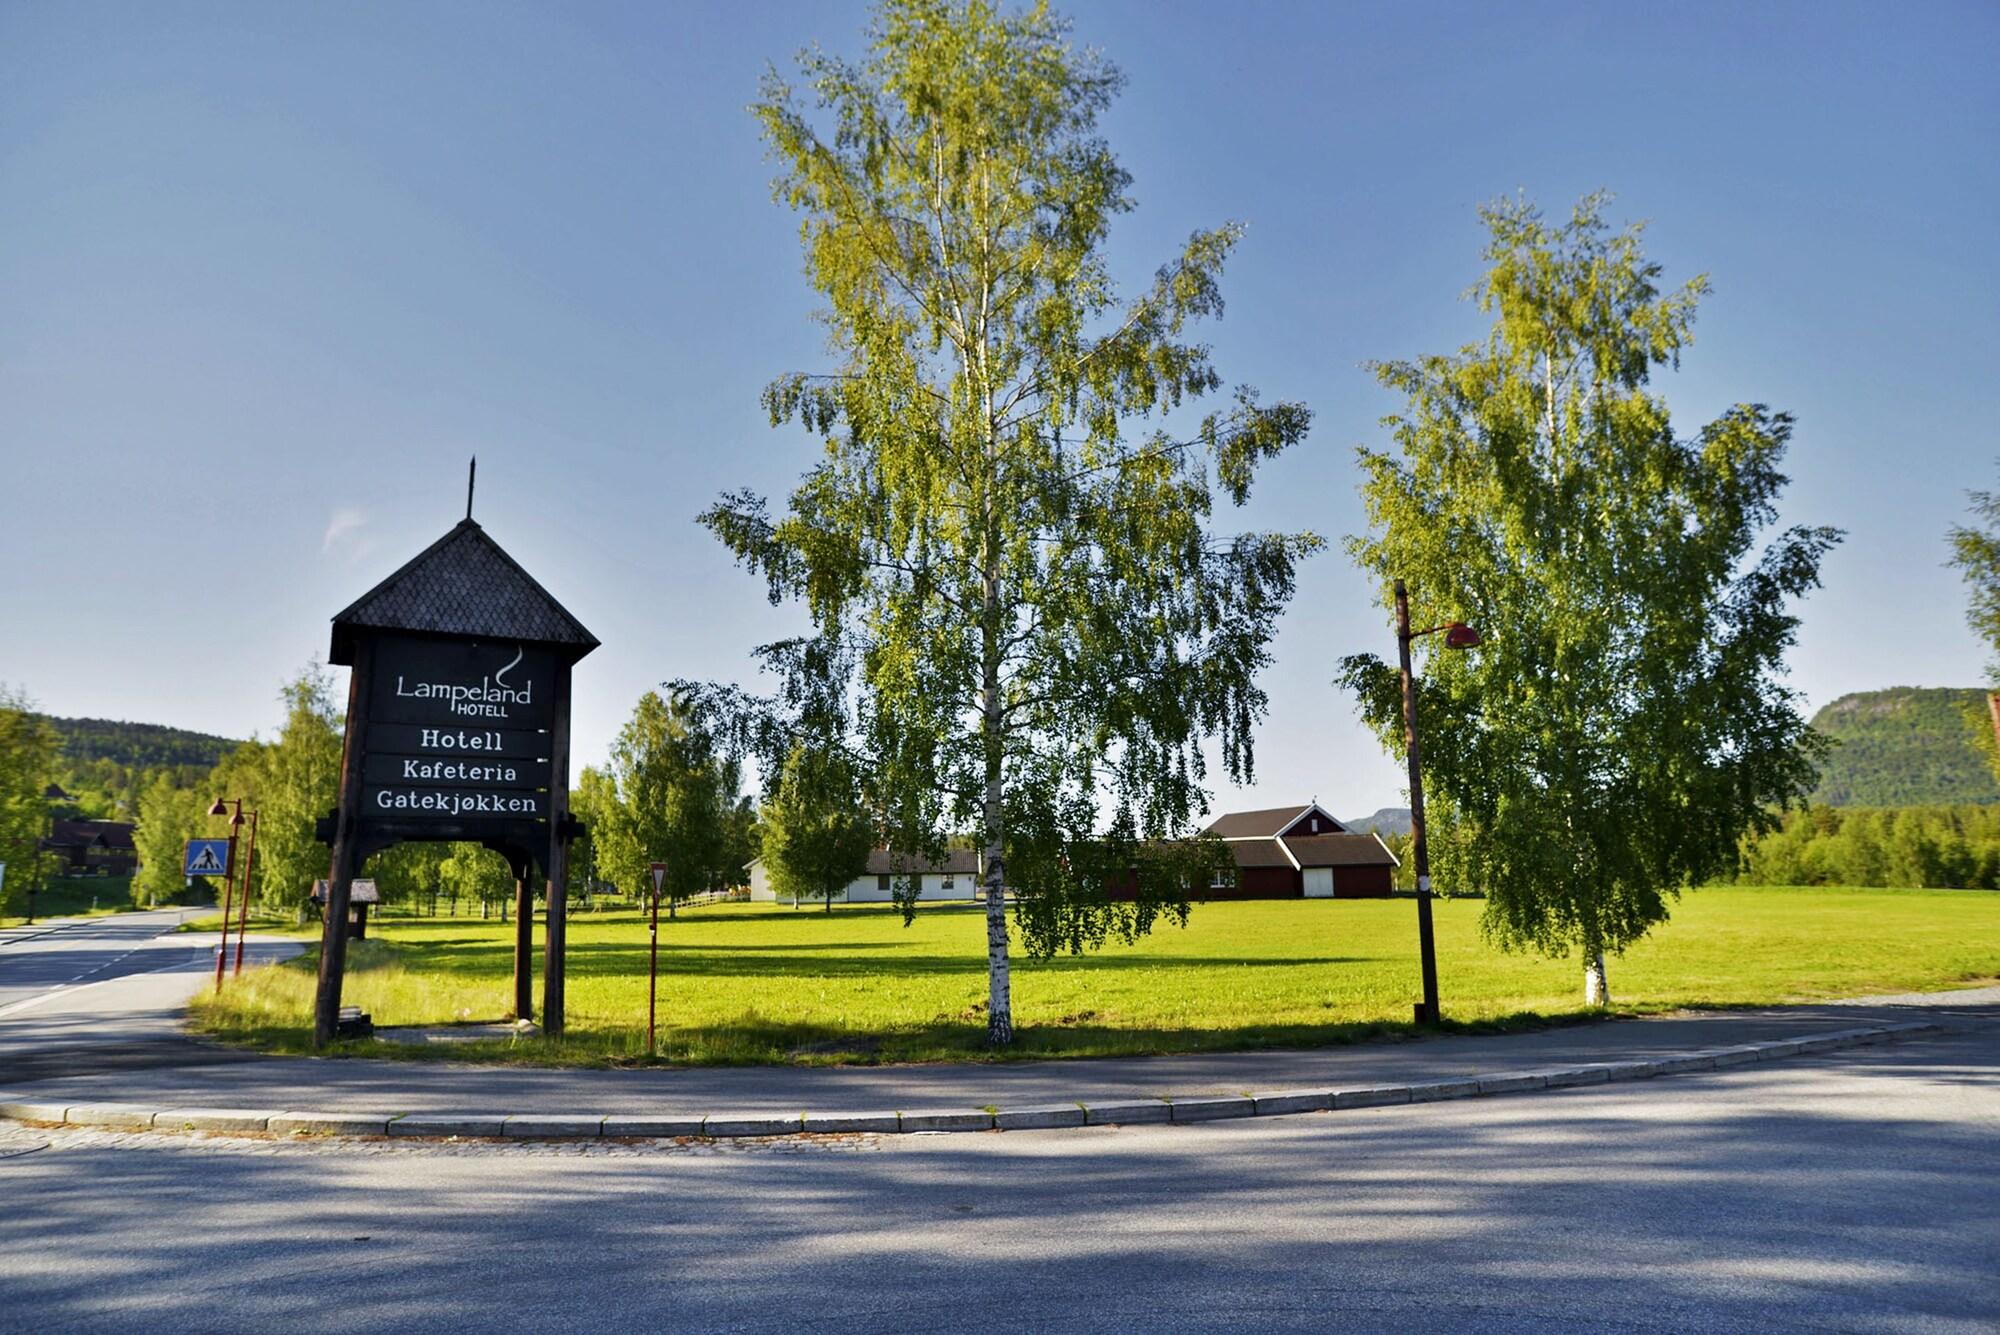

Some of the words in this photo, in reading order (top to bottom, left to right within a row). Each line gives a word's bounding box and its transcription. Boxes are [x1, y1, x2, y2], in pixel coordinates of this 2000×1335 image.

[396, 676, 532, 712] Lampeland
[457, 703, 508, 717] HOTELL
[420, 729, 502, 750] Hotell
[402, 760, 517, 781] Kafeteria
[377, 790, 536, 815] Gatekjøkken
